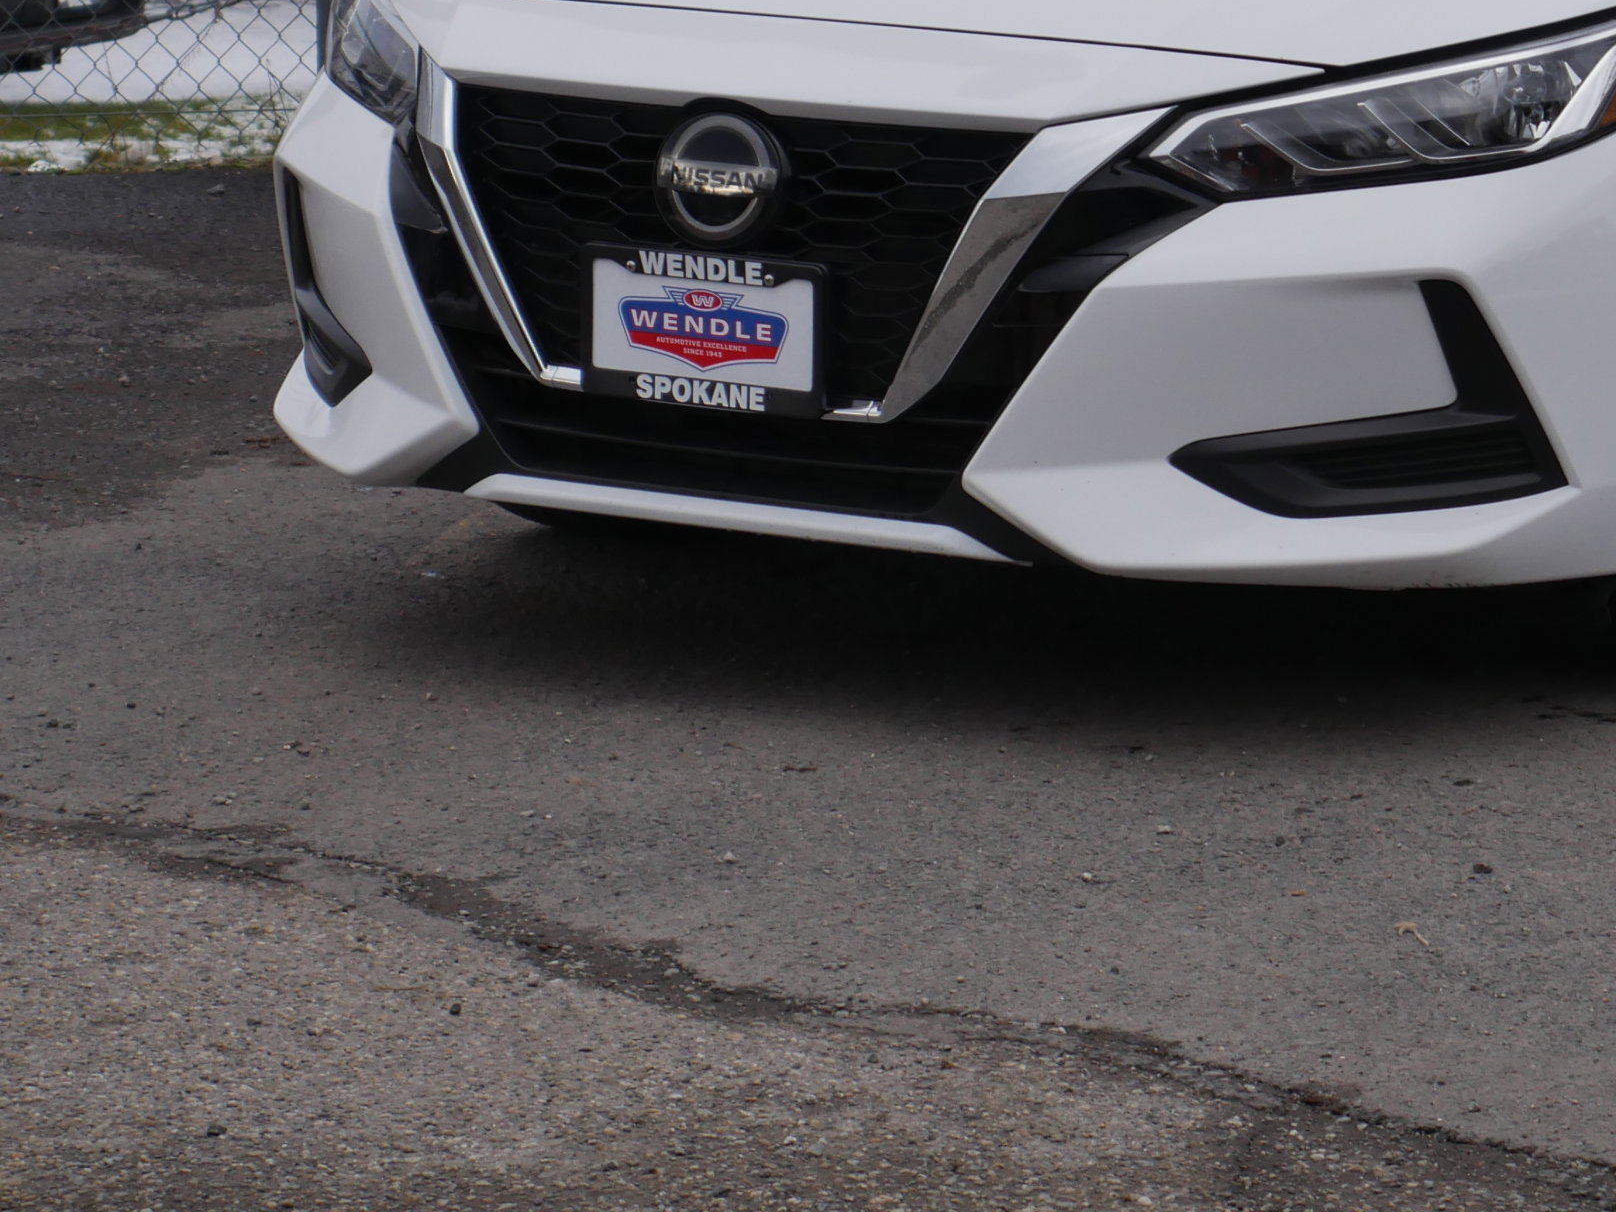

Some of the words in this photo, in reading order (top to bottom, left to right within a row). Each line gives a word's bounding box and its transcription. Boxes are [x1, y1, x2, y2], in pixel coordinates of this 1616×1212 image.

[671, 164, 765, 190] NISSAN
[639, 251, 762, 286] WENDLE
[631, 309, 772, 341] WENDLE
[656, 335, 701, 348] AUTOMOTIVE
[702, 340, 748, 353] EXCELLENCE
[682, 347, 704, 356] SINCE
[636, 375, 765, 411] SPOKANE
